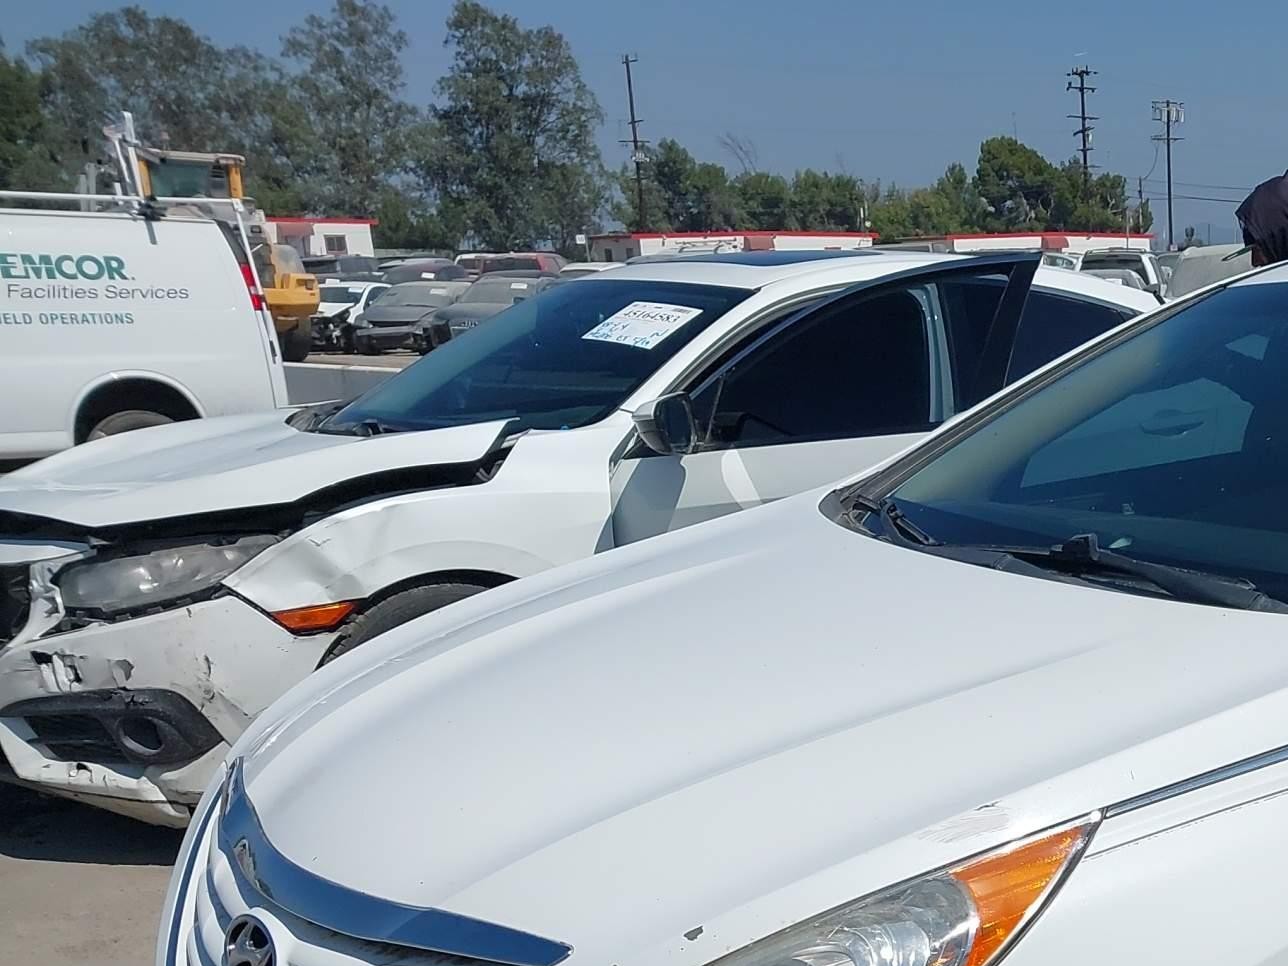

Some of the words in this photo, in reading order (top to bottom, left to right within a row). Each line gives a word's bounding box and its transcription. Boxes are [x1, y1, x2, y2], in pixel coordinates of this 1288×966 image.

[7, 284, 99, 299] Facilities
[105, 285, 190, 299] Services
[39, 313, 134, 325] OPERATIONS
